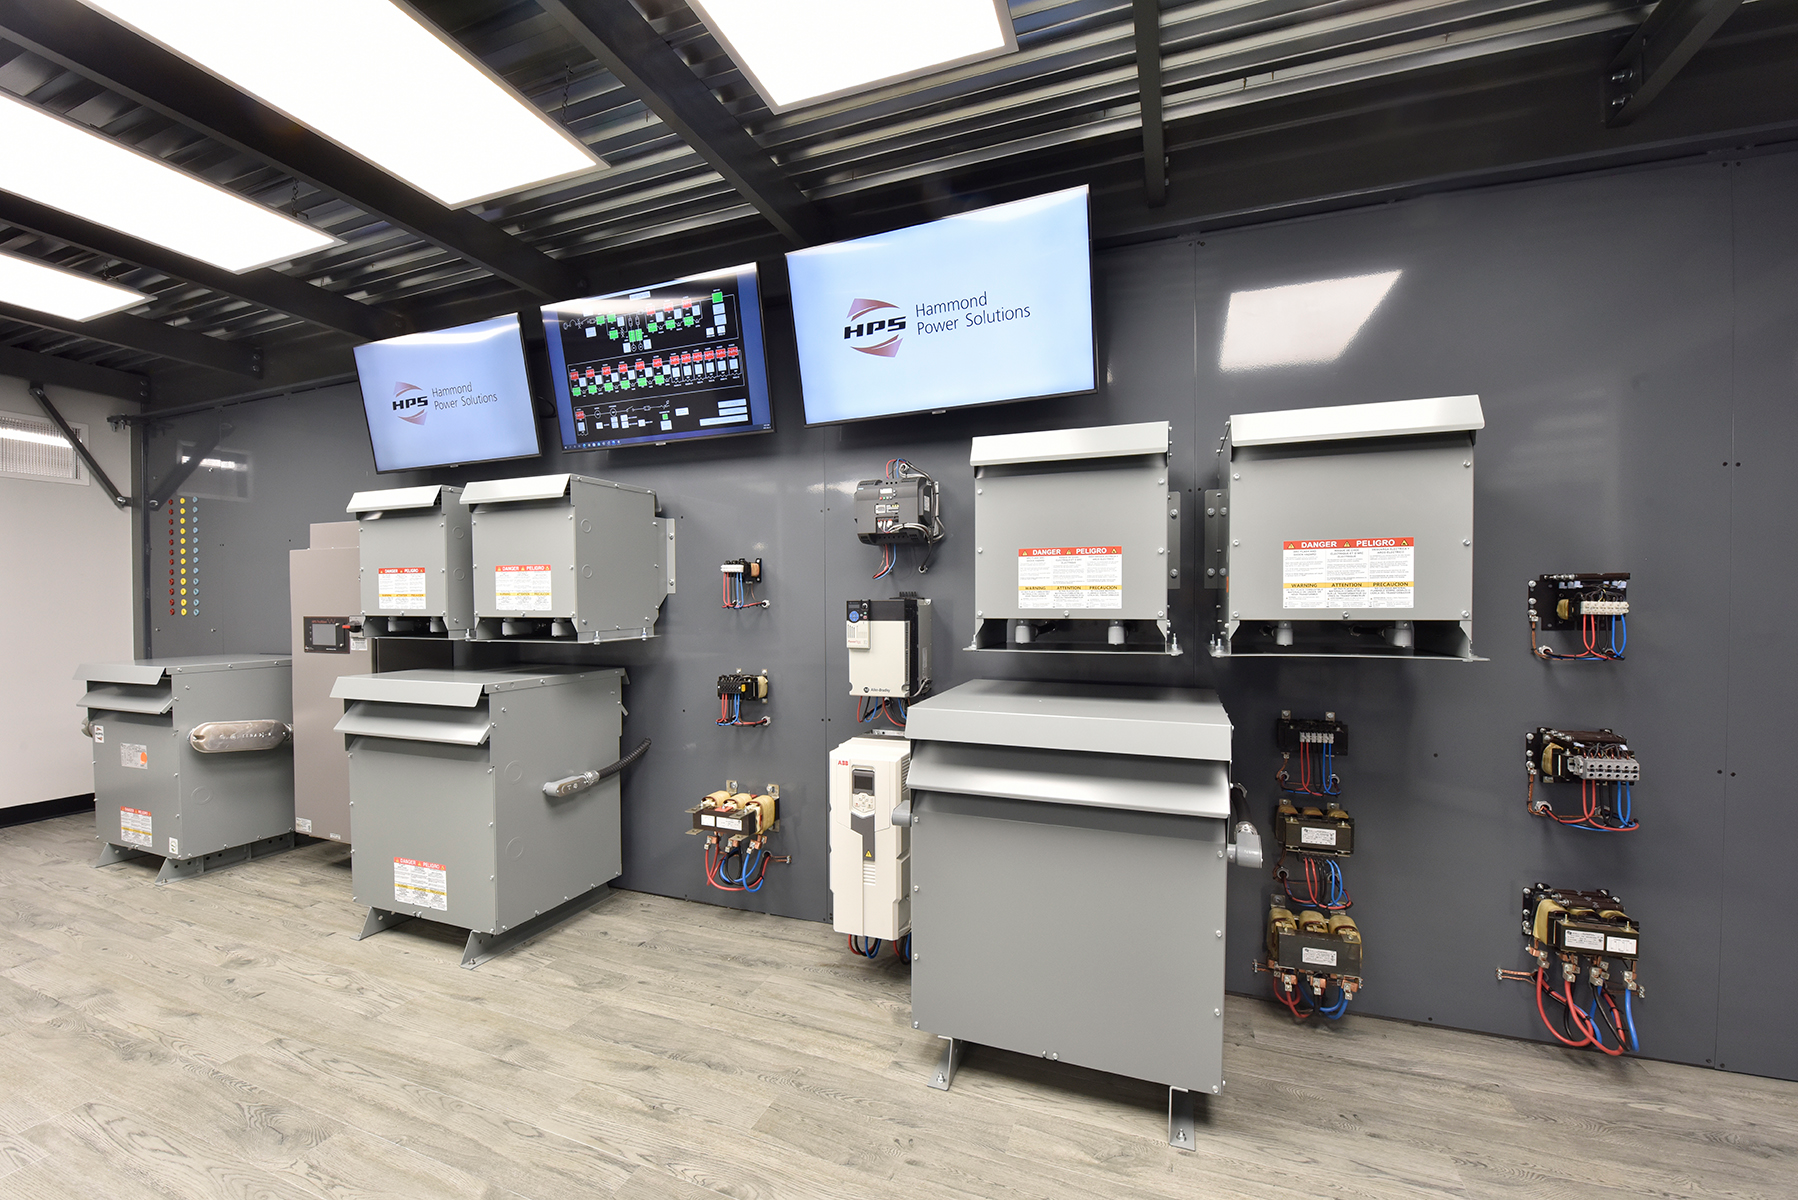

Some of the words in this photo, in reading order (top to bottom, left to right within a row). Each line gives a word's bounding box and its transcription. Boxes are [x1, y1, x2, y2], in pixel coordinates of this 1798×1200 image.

[915, 291, 987, 317] Hammond
[844, 316, 906, 339] HPS
[917, 318, 958, 335] Power
[966, 306, 1031, 327] Solutions
[432, 382, 473, 397] Hammond
[392, 396, 428, 410] HPS
[434, 400, 458, 410] Power
[460, 393, 498, 407] Solutions
[1076, 547, 1107, 555] PELIGRO
[1356, 539, 1395, 547] PELIGRO
